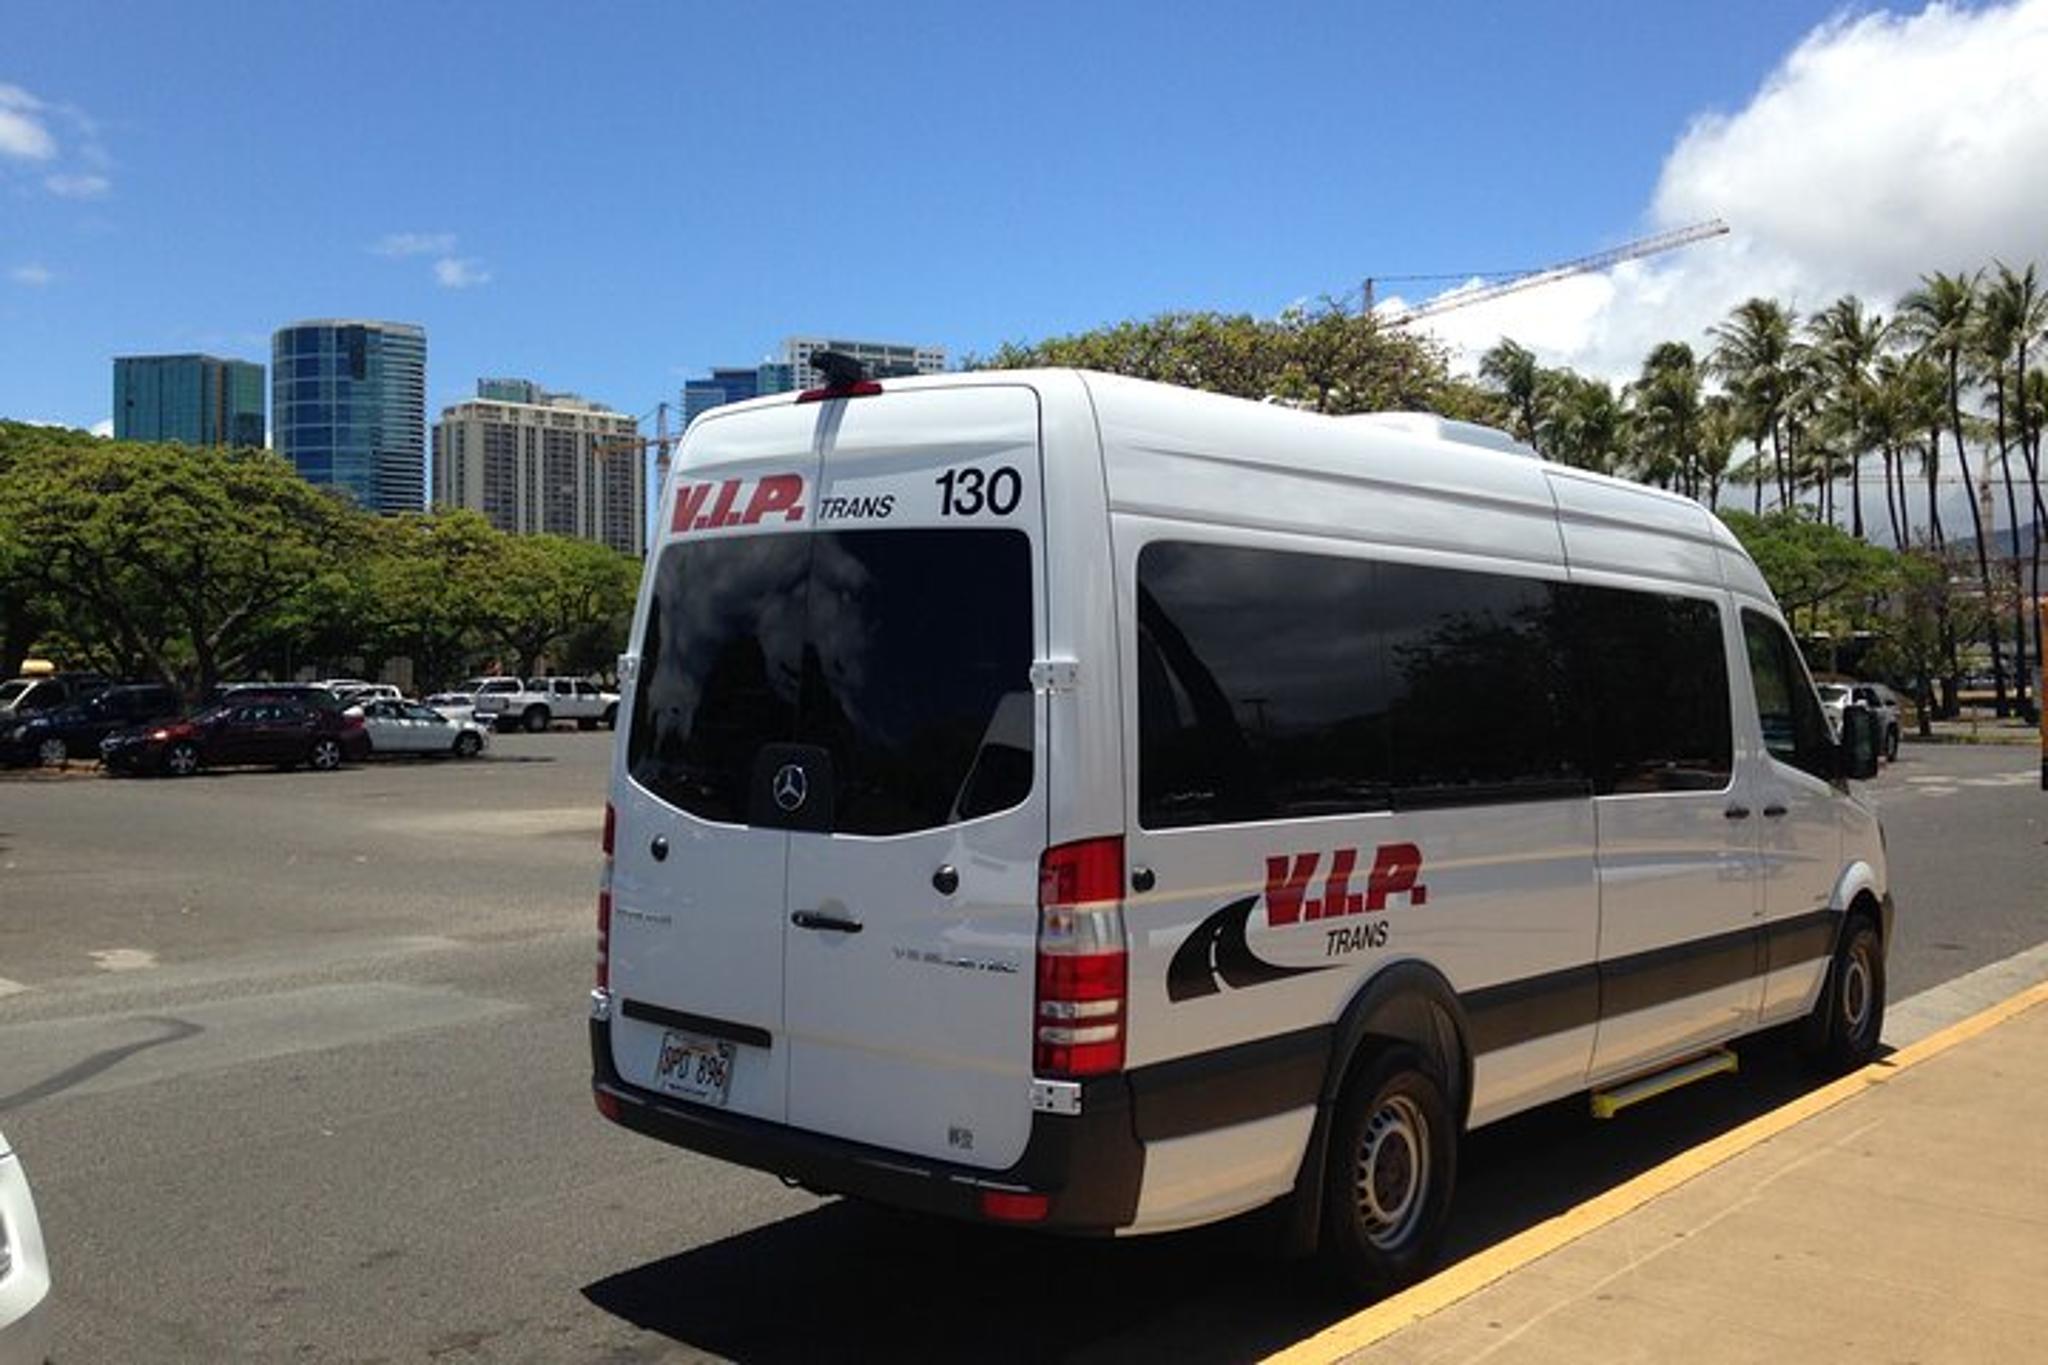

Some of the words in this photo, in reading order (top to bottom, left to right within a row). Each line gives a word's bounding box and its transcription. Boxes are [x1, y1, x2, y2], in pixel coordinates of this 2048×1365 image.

[671, 472, 805, 533] V.I.P.
[818, 494, 895, 520] TRANS
[935, 465, 1023, 516] 130
[1265, 842, 1427, 928] V.I.P.
[1325, 919, 1390, 957] TRANS
